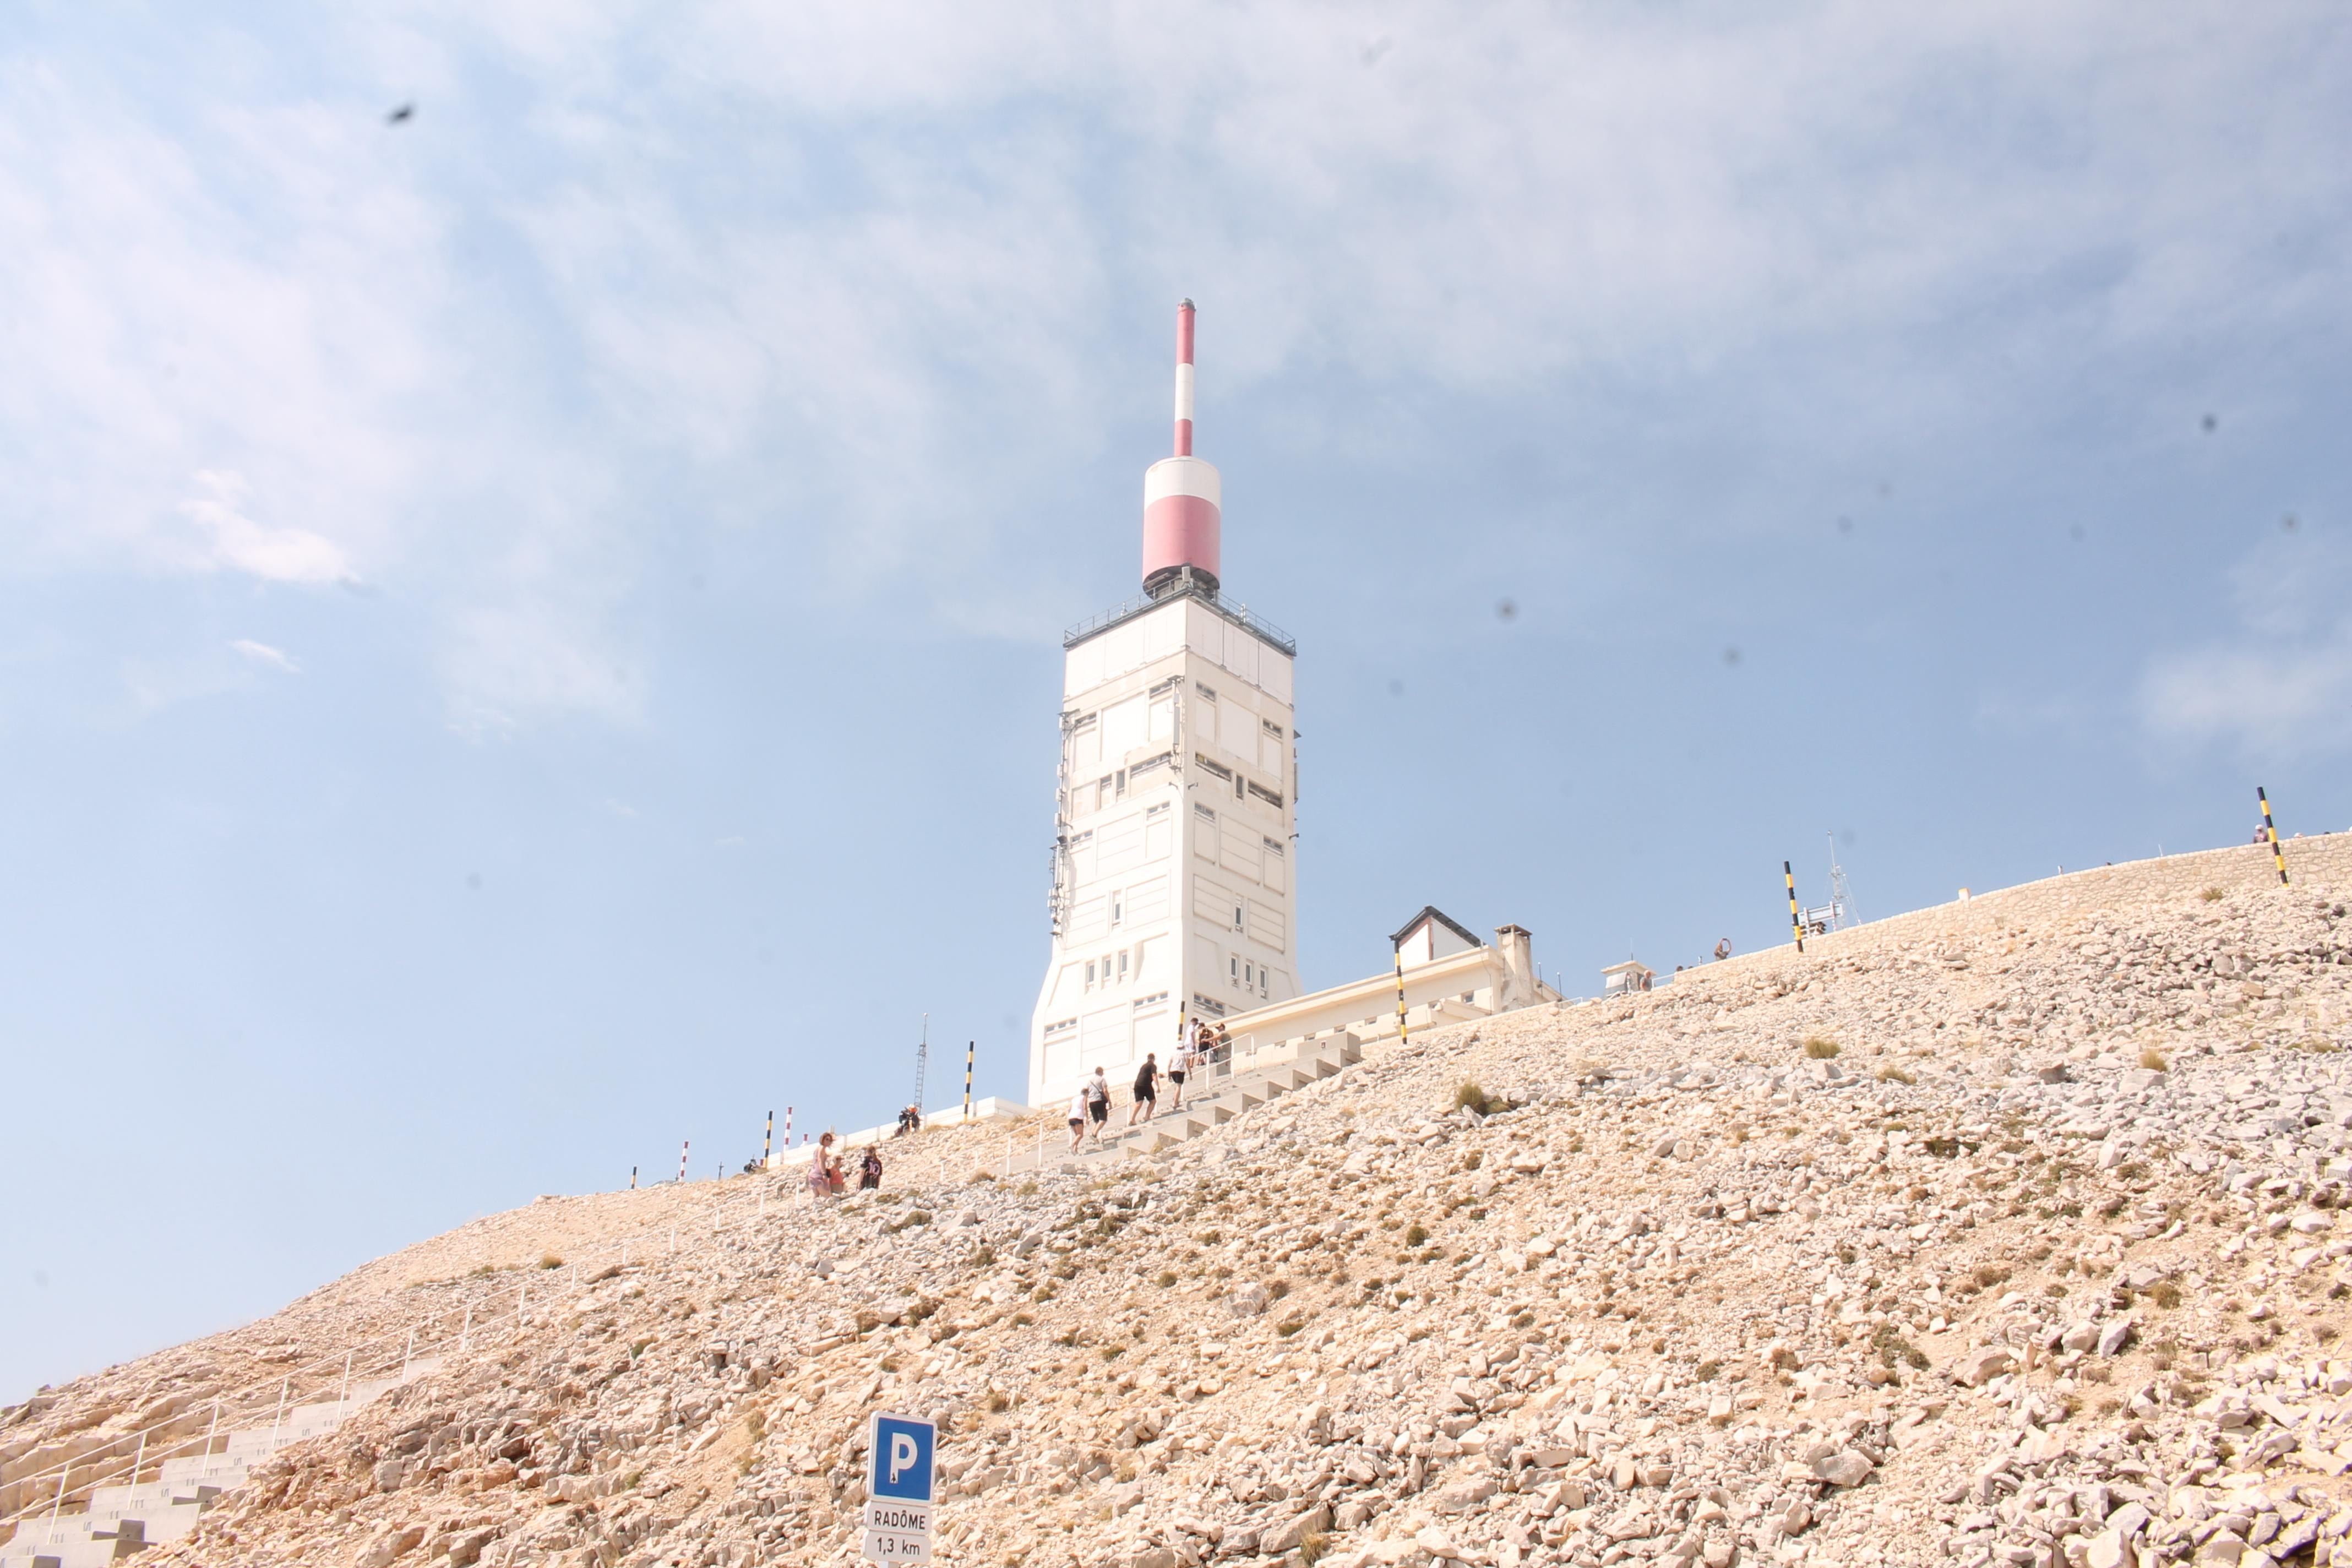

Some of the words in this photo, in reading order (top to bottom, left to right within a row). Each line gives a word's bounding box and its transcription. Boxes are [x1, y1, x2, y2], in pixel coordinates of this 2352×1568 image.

[868, 1162, 880, 1175] 10
[890, 1433, 918, 1483] P
[874, 1510, 925, 1530] RADÔME
[877, 1537, 894, 1555] 1,3
[902, 1539, 920, 1555] km
